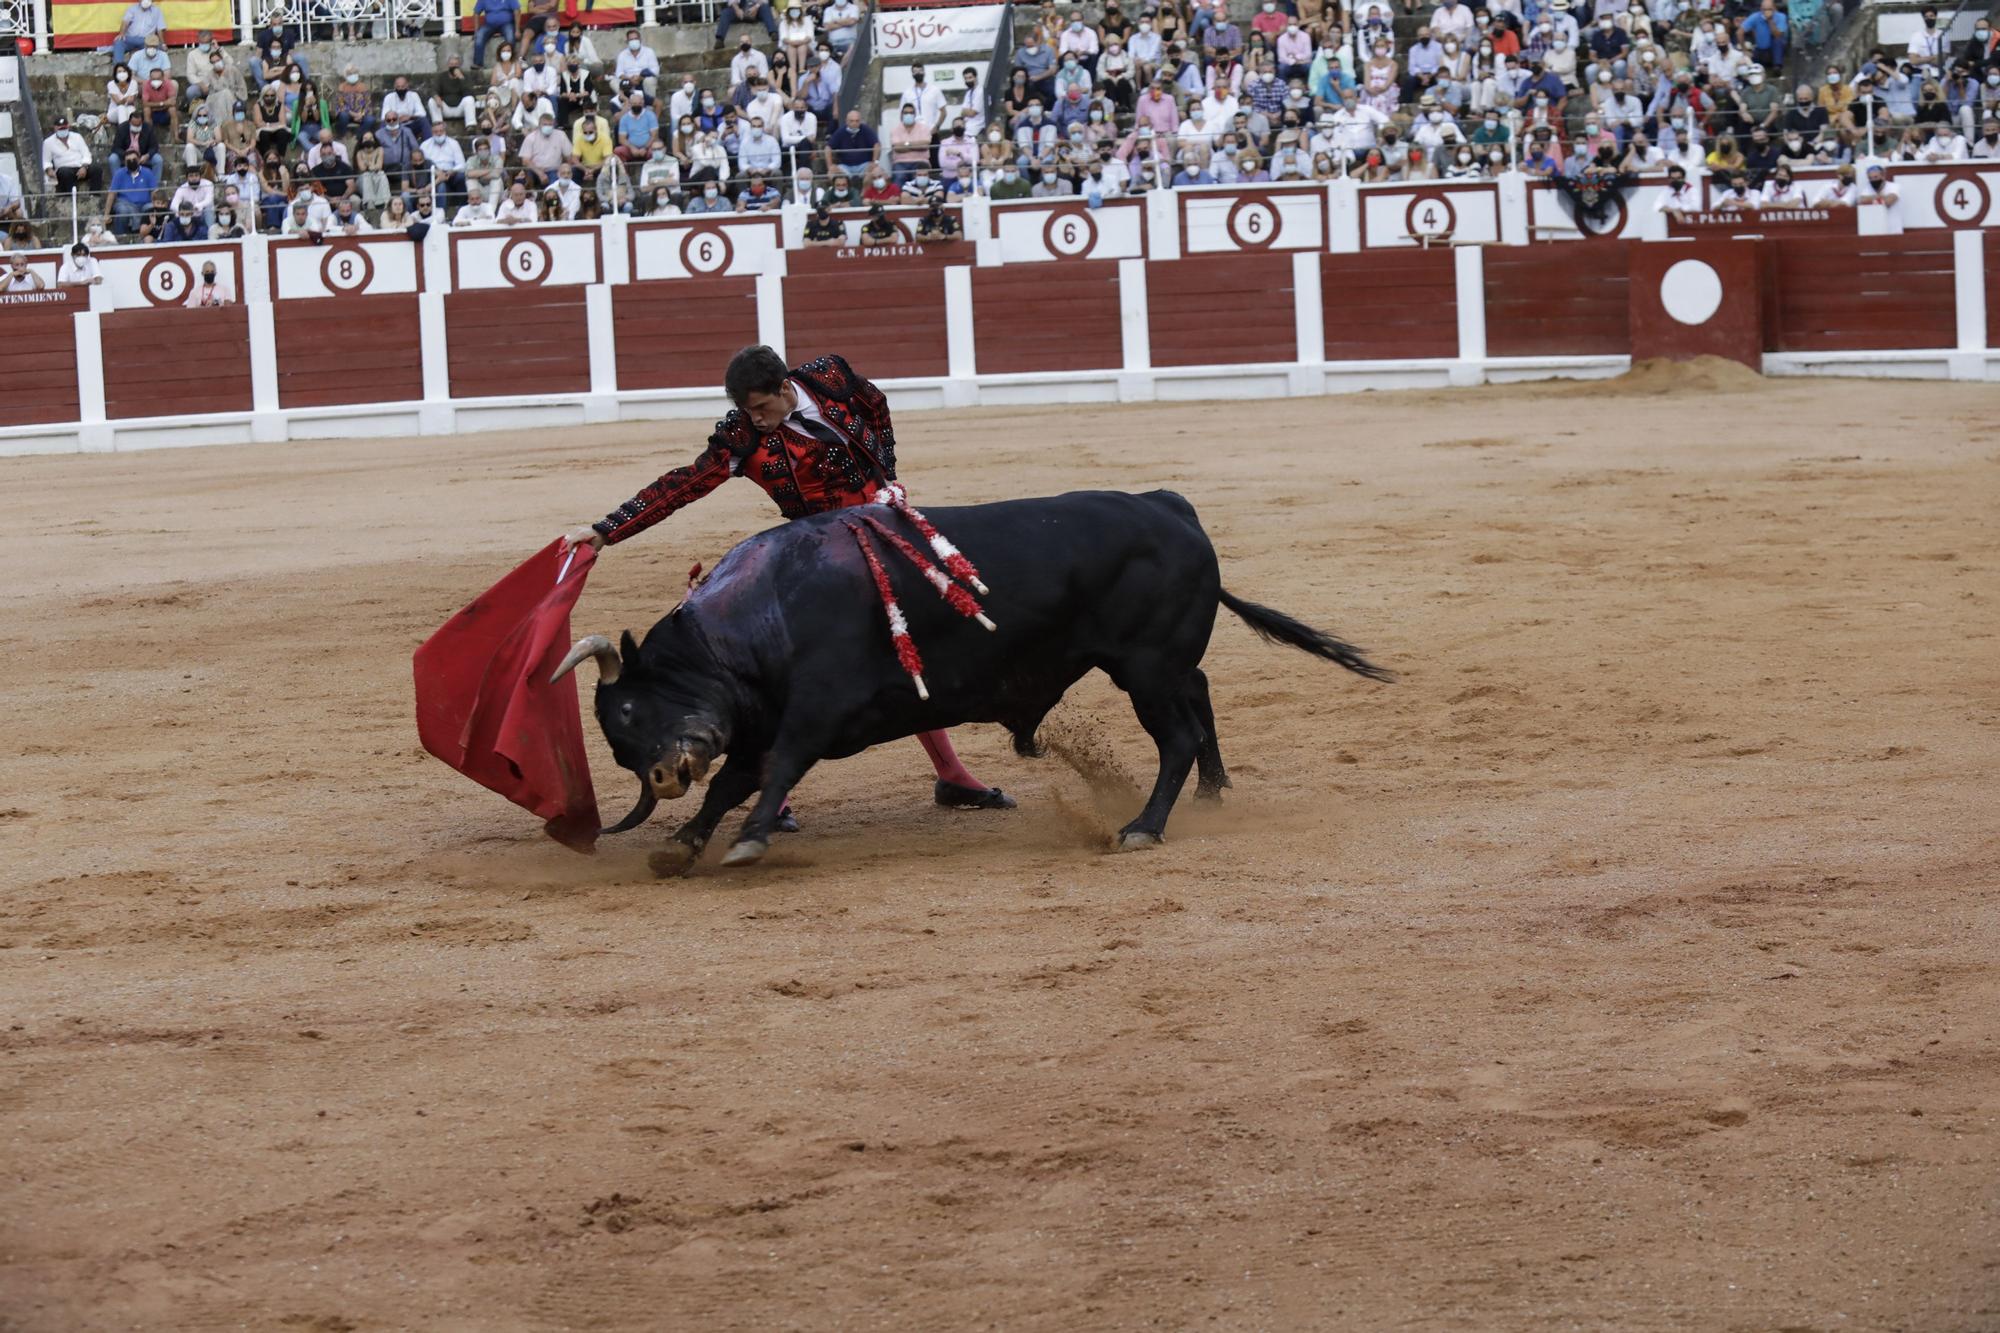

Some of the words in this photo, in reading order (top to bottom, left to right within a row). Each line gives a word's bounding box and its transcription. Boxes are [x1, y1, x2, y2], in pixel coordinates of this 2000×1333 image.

[882, 16, 952, 49] gijón
[1953, 188, 1969, 210] 4
[1249, 212, 1262, 234] 6
[1423, 207, 1437, 229] 4
[1699, 212, 1742, 224] PLAZA
[1759, 210, 1829, 222] ARENEROS
[1063, 222, 1076, 244] 6
[519, 250, 532, 271] 6
[699, 241, 713, 262] 6
[836, 247, 860, 258] C.N.
[863, 245, 924, 257] POLICIA
[339, 259, 353, 280] 8
[160, 270, 173, 291] 8
